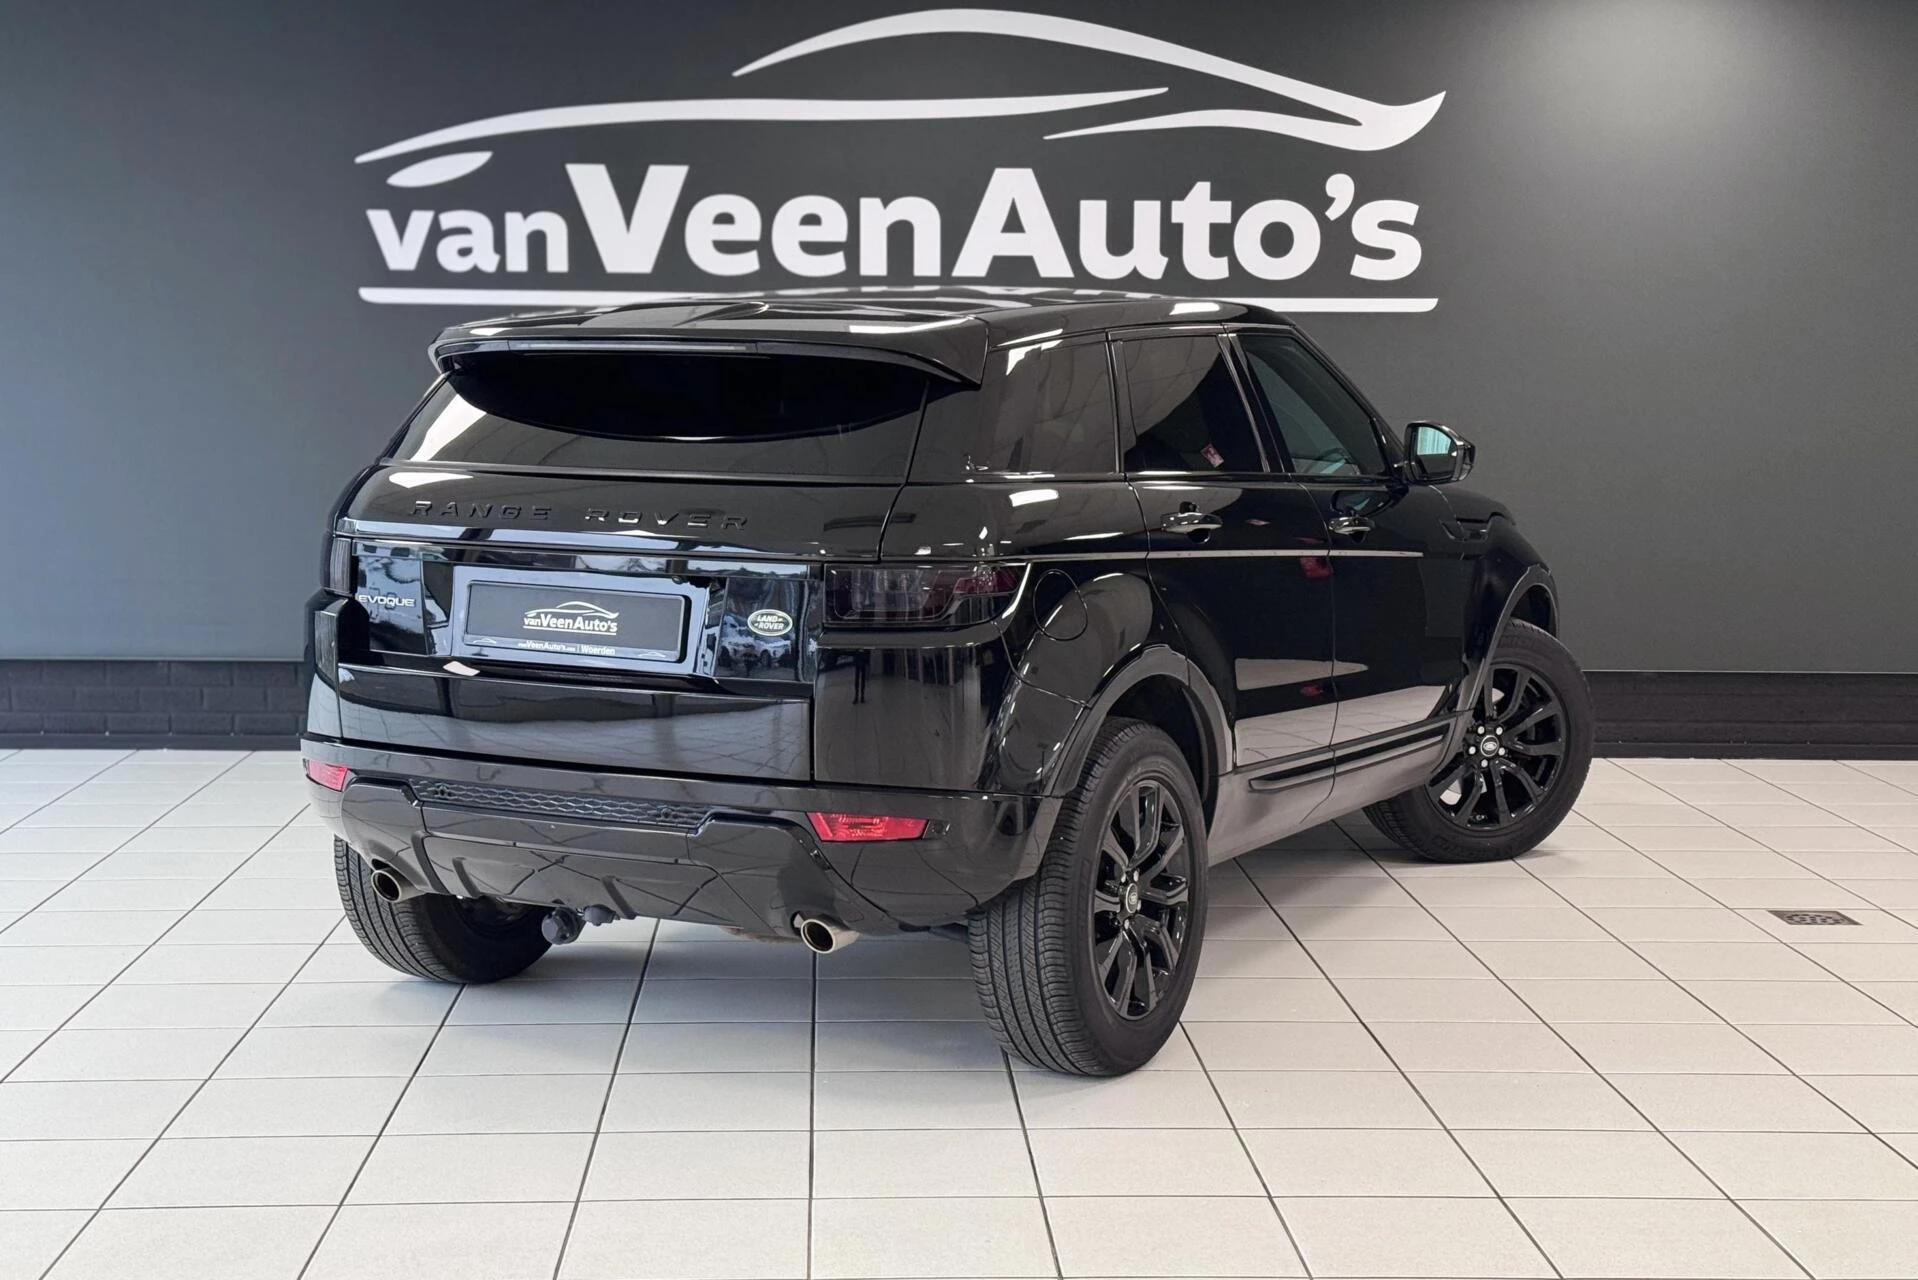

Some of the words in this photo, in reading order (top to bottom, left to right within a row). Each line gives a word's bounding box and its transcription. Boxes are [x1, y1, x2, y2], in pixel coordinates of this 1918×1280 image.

[412, 499, 553, 521] RANGE
[583, 506, 750, 531] ROVER
[359, 594, 416, 607] EVOQUE
[757, 614, 778, 623] LAND
[758, 621, 785, 630] ROVER
[581, 645, 616, 655] Woerden
